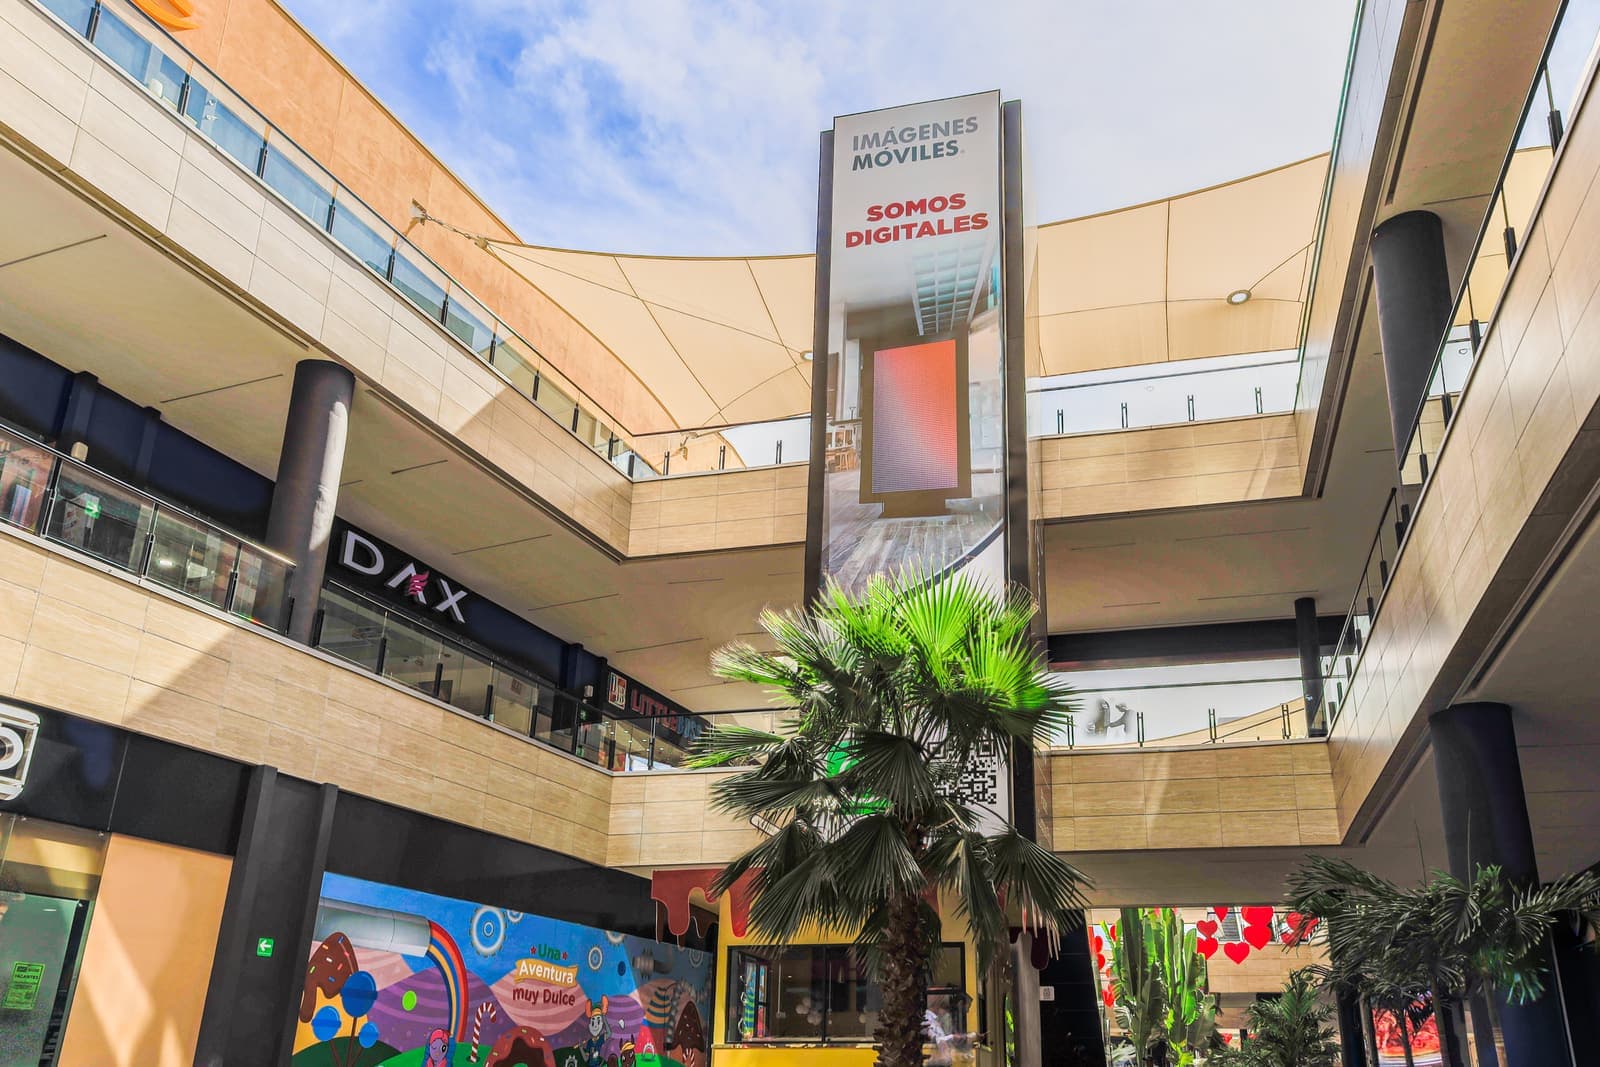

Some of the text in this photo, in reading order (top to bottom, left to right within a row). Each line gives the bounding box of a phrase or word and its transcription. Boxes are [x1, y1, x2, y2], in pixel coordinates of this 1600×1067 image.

[853, 117, 978, 151] IMÁGENES
[852, 140, 959, 171] MÓVILES
[867, 193, 966, 222] SOMOS
[846, 213, 989, 248] DIGITALES
[343, 530, 468, 623] DAX
[631, 688, 677, 732] LITTLE
[538, 943, 561, 960] Una
[519, 960, 574, 984] Aventura
[512, 987, 576, 1006] muy Dulce
